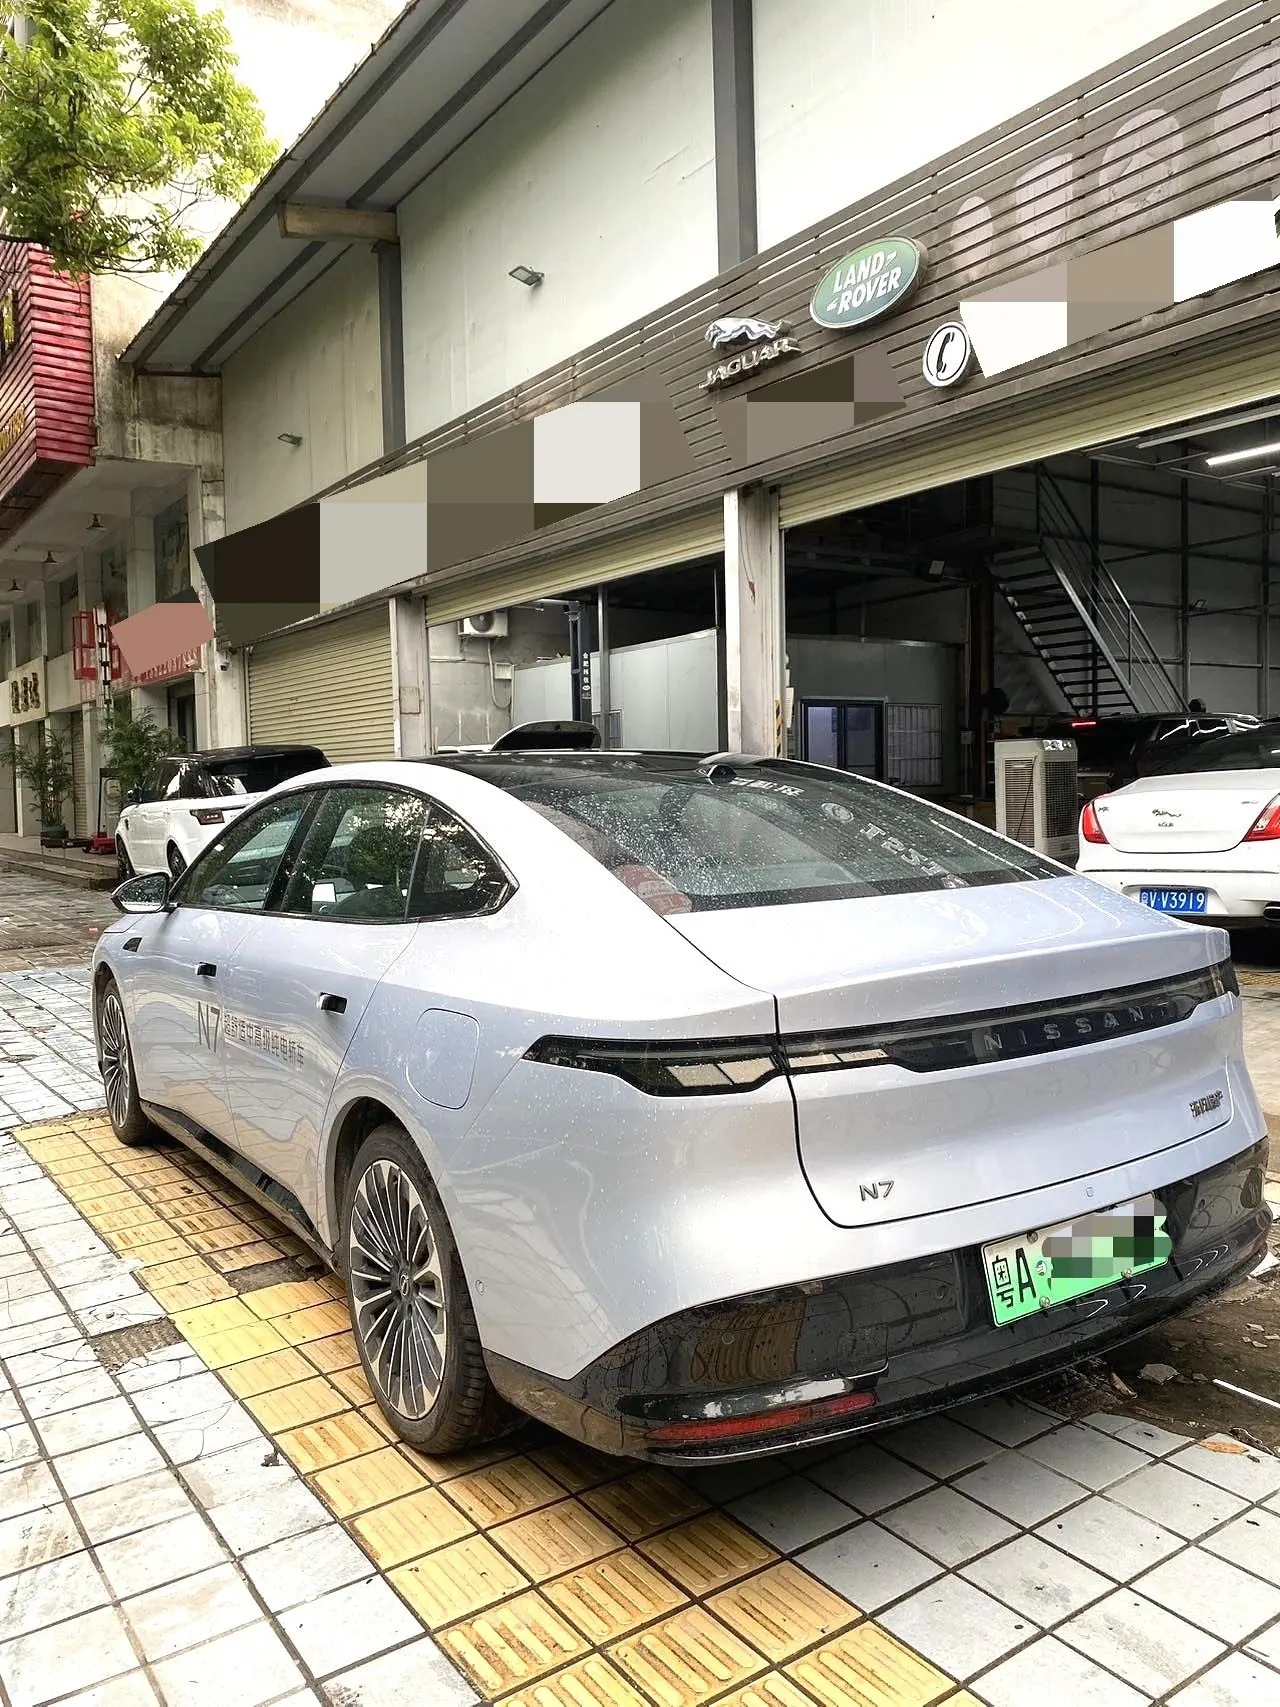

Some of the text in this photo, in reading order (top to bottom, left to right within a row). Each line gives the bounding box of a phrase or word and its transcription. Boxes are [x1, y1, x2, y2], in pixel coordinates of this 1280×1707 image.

[699, 337, 802, 389] JAGUAR
[197, 1001, 220, 1054] N7
[983, 1004, 1145, 1052] NISSAN
[859, 1180, 895, 1202] N7
